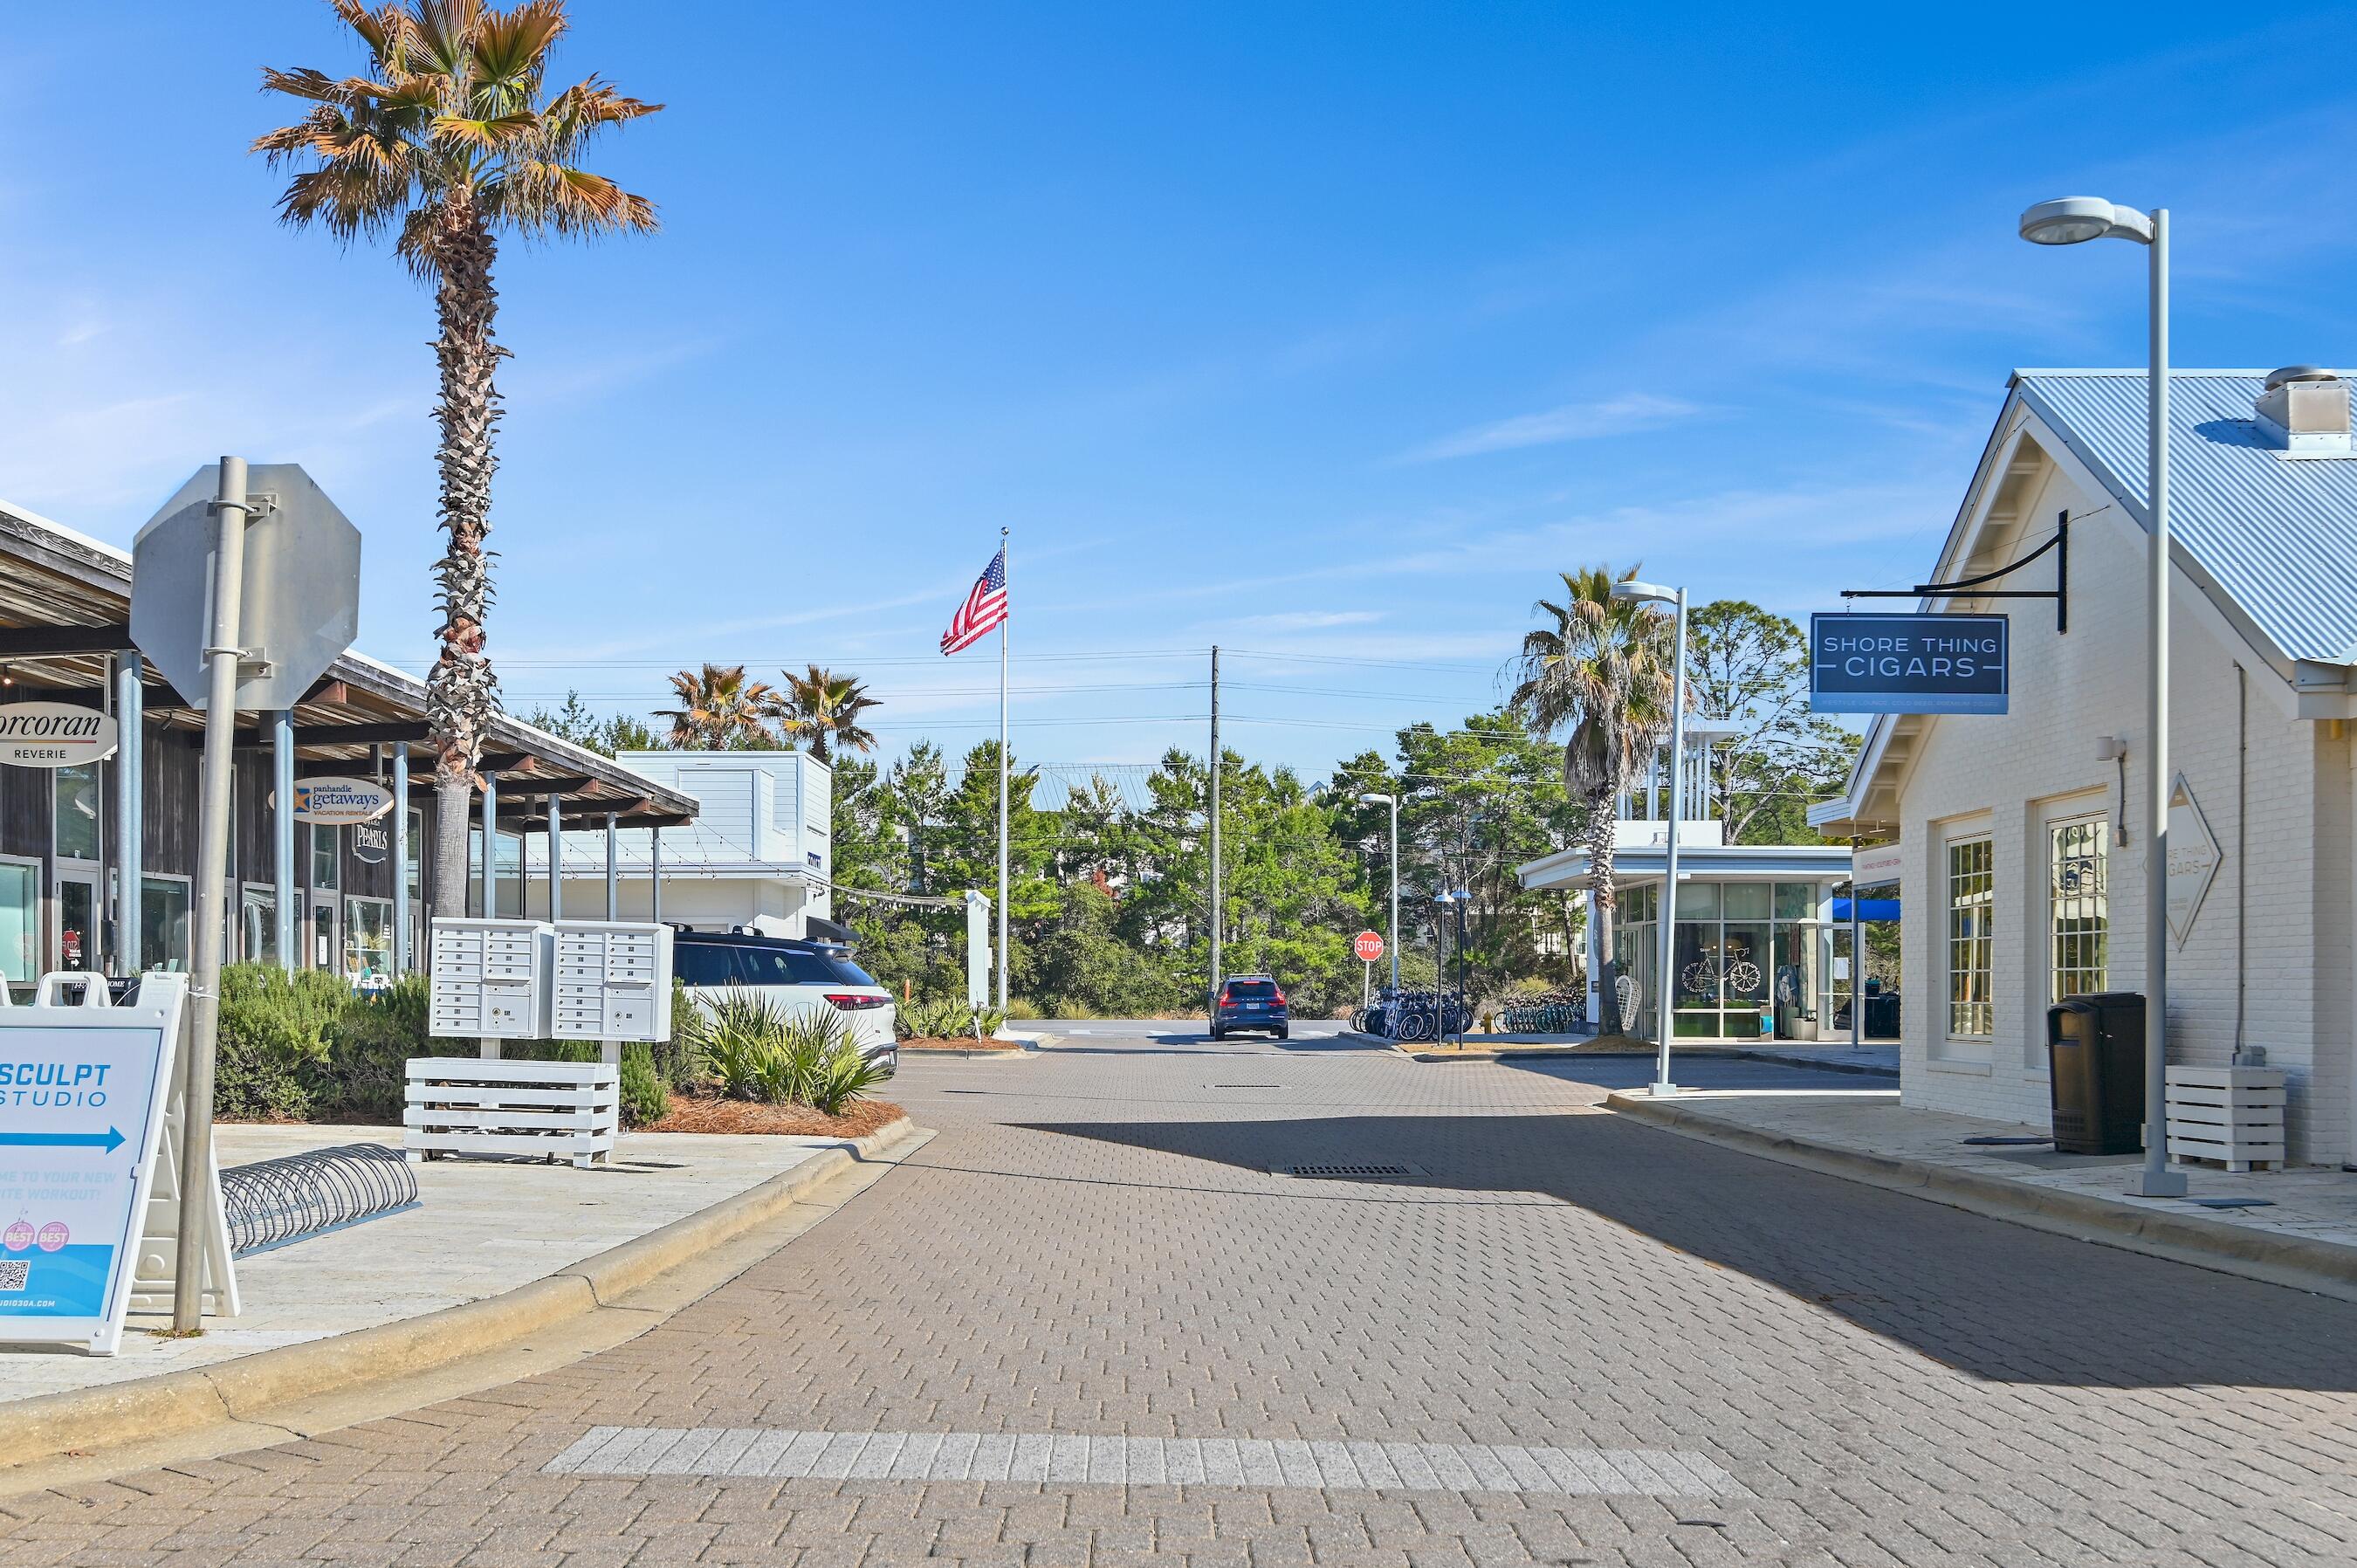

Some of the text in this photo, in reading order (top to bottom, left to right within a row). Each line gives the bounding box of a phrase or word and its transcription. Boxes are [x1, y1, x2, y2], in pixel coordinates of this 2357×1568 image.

[1824, 637, 1996, 653] SHORE THING
[1845, 657, 1975, 677] CIGARS
[14, 749, 66, 759] REVERIE
[313, 784, 352, 794] panhandle
[313, 793, 379, 809] getaways
[356, 824, 388, 849] PEARLS
[1357, 940, 1382, 952] STOP
[0, 1063, 111, 1086] SCULPT
[22, 1172, 39, 1183] TO
[44, 1172, 81, 1183] YOUR
[85, 1173, 117, 1184] NEW
[28, 1189, 101, 1200] WORKOUT!
[6, 1232, 33, 1242] BEST
[40, 1232, 67, 1243] BEST
